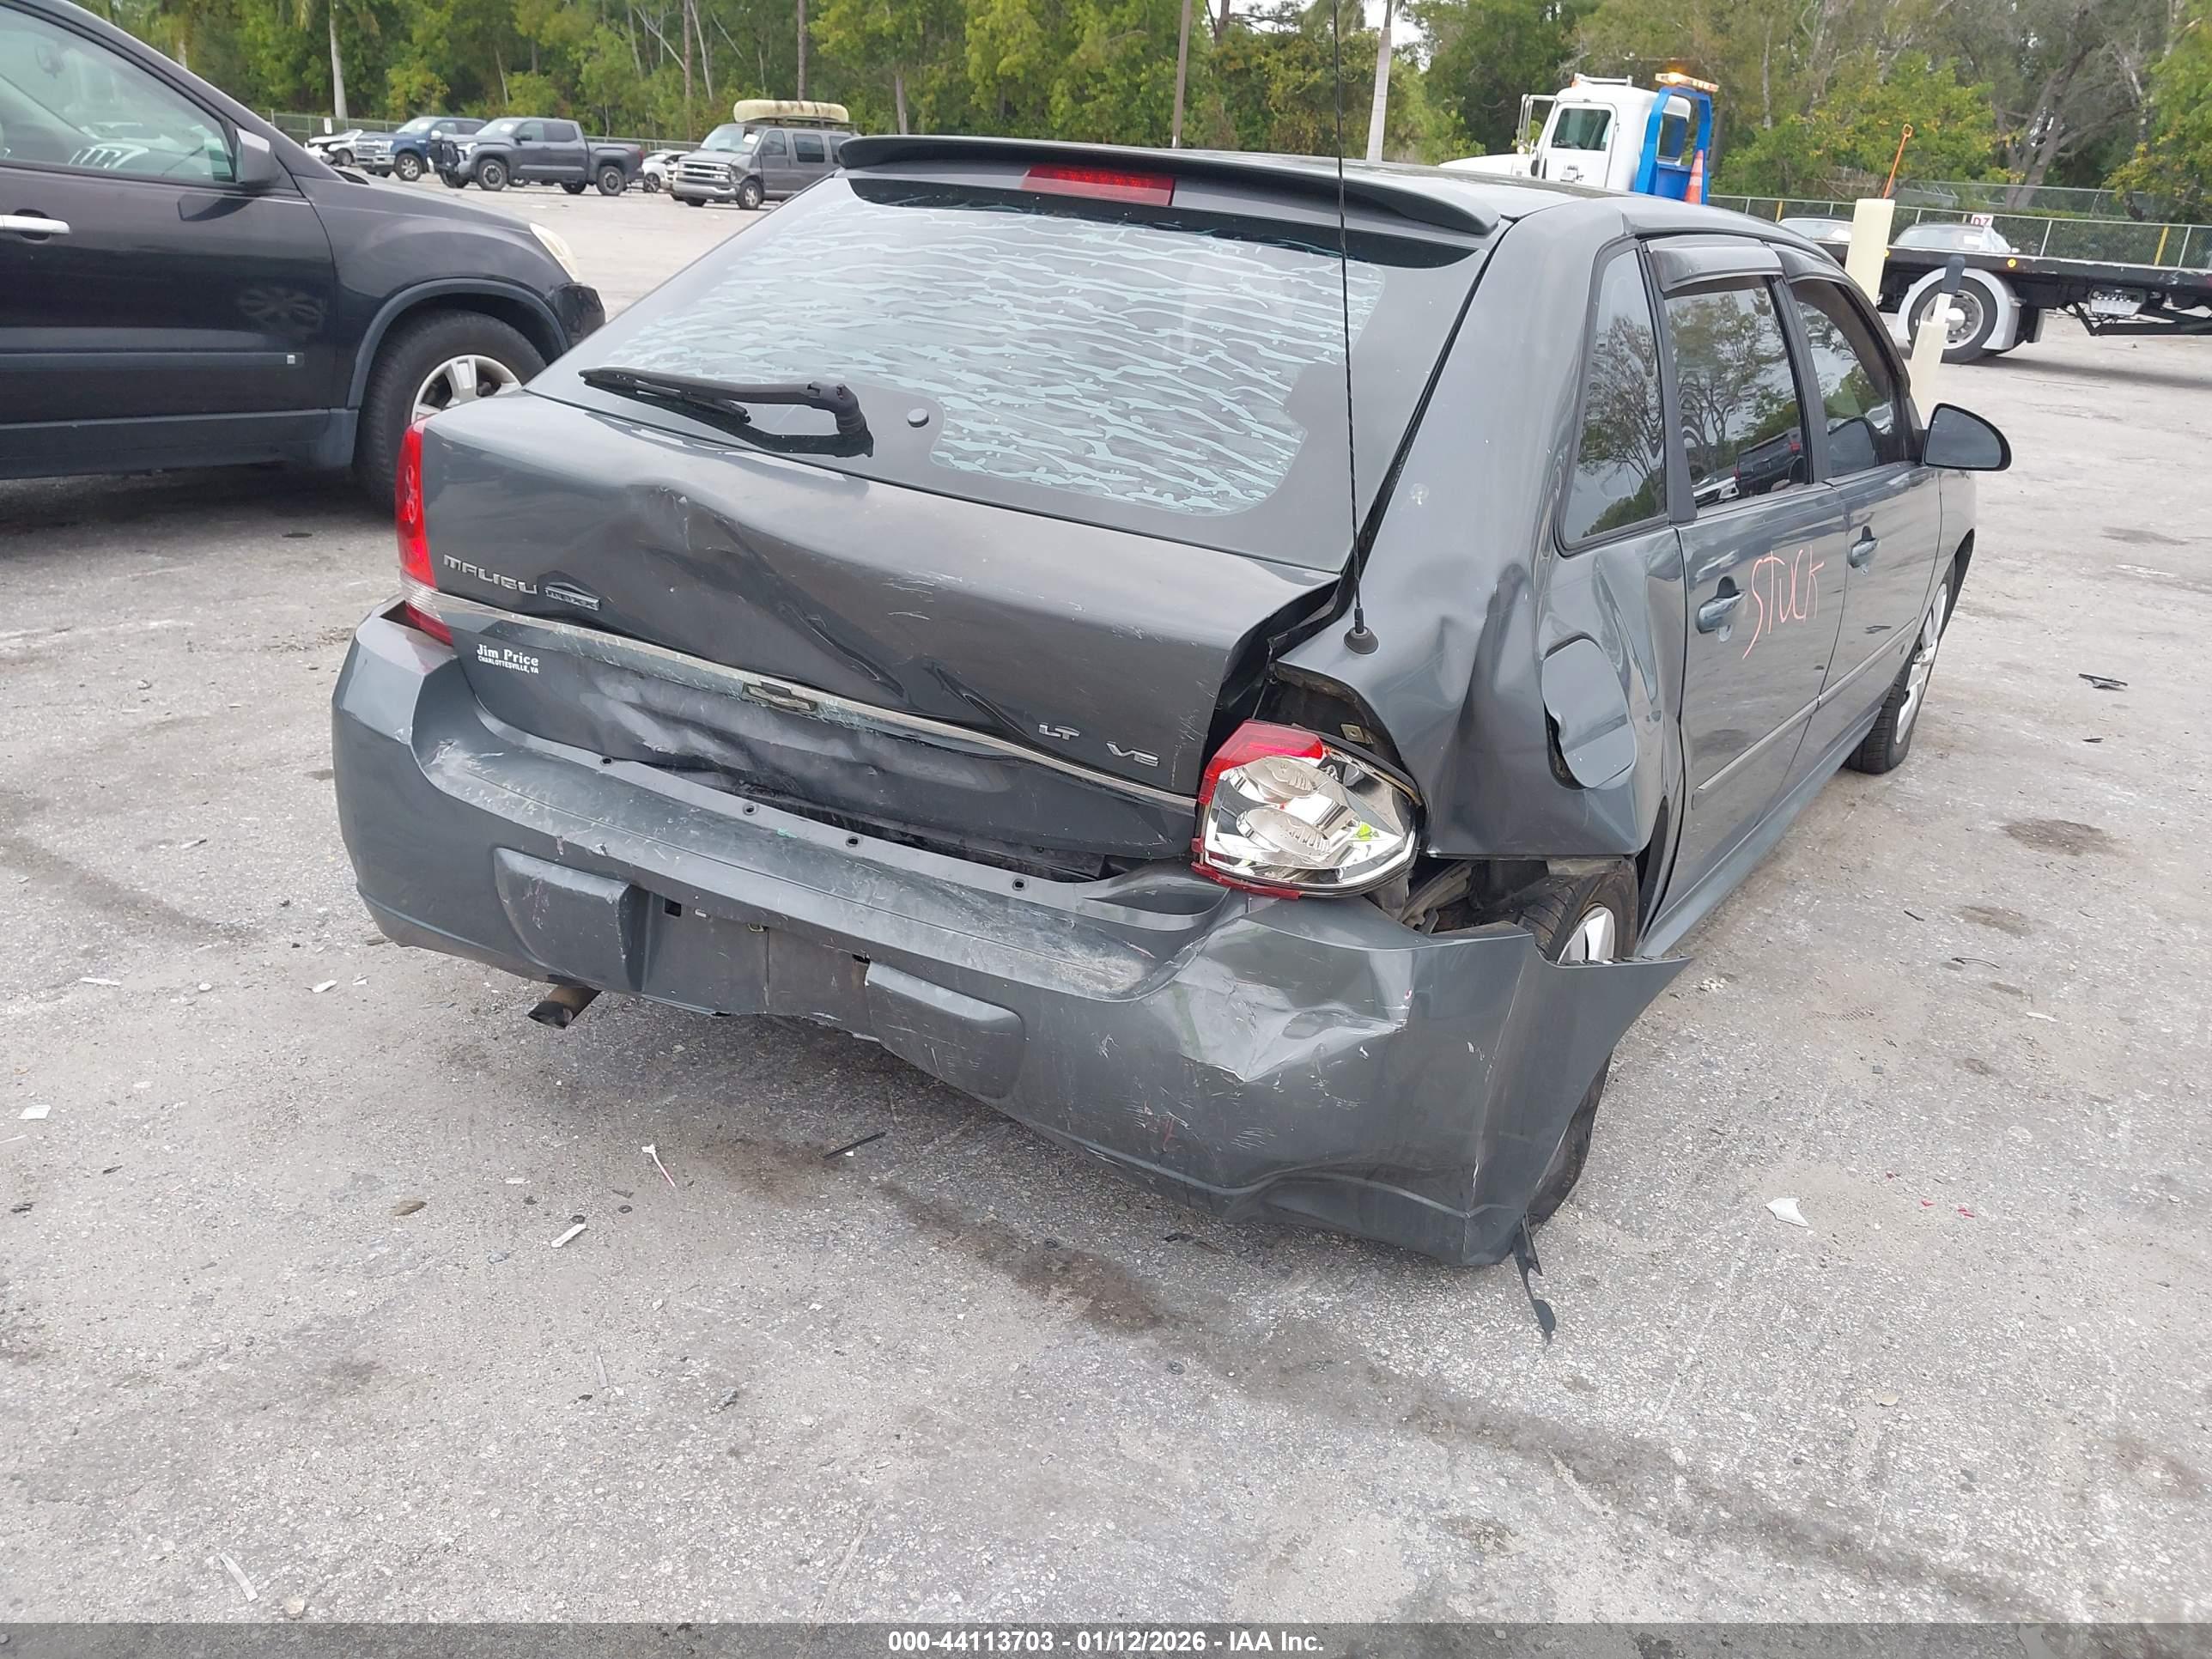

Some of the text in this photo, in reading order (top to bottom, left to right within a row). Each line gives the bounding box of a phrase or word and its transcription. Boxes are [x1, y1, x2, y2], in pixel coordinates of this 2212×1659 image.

[443, 554, 538, 595] MALIBU
[477, 643, 539, 666] Jim Price
[477, 655, 530, 673] CHARLOTTESVILLE,
[1038, 722, 1160, 767] LT V6
